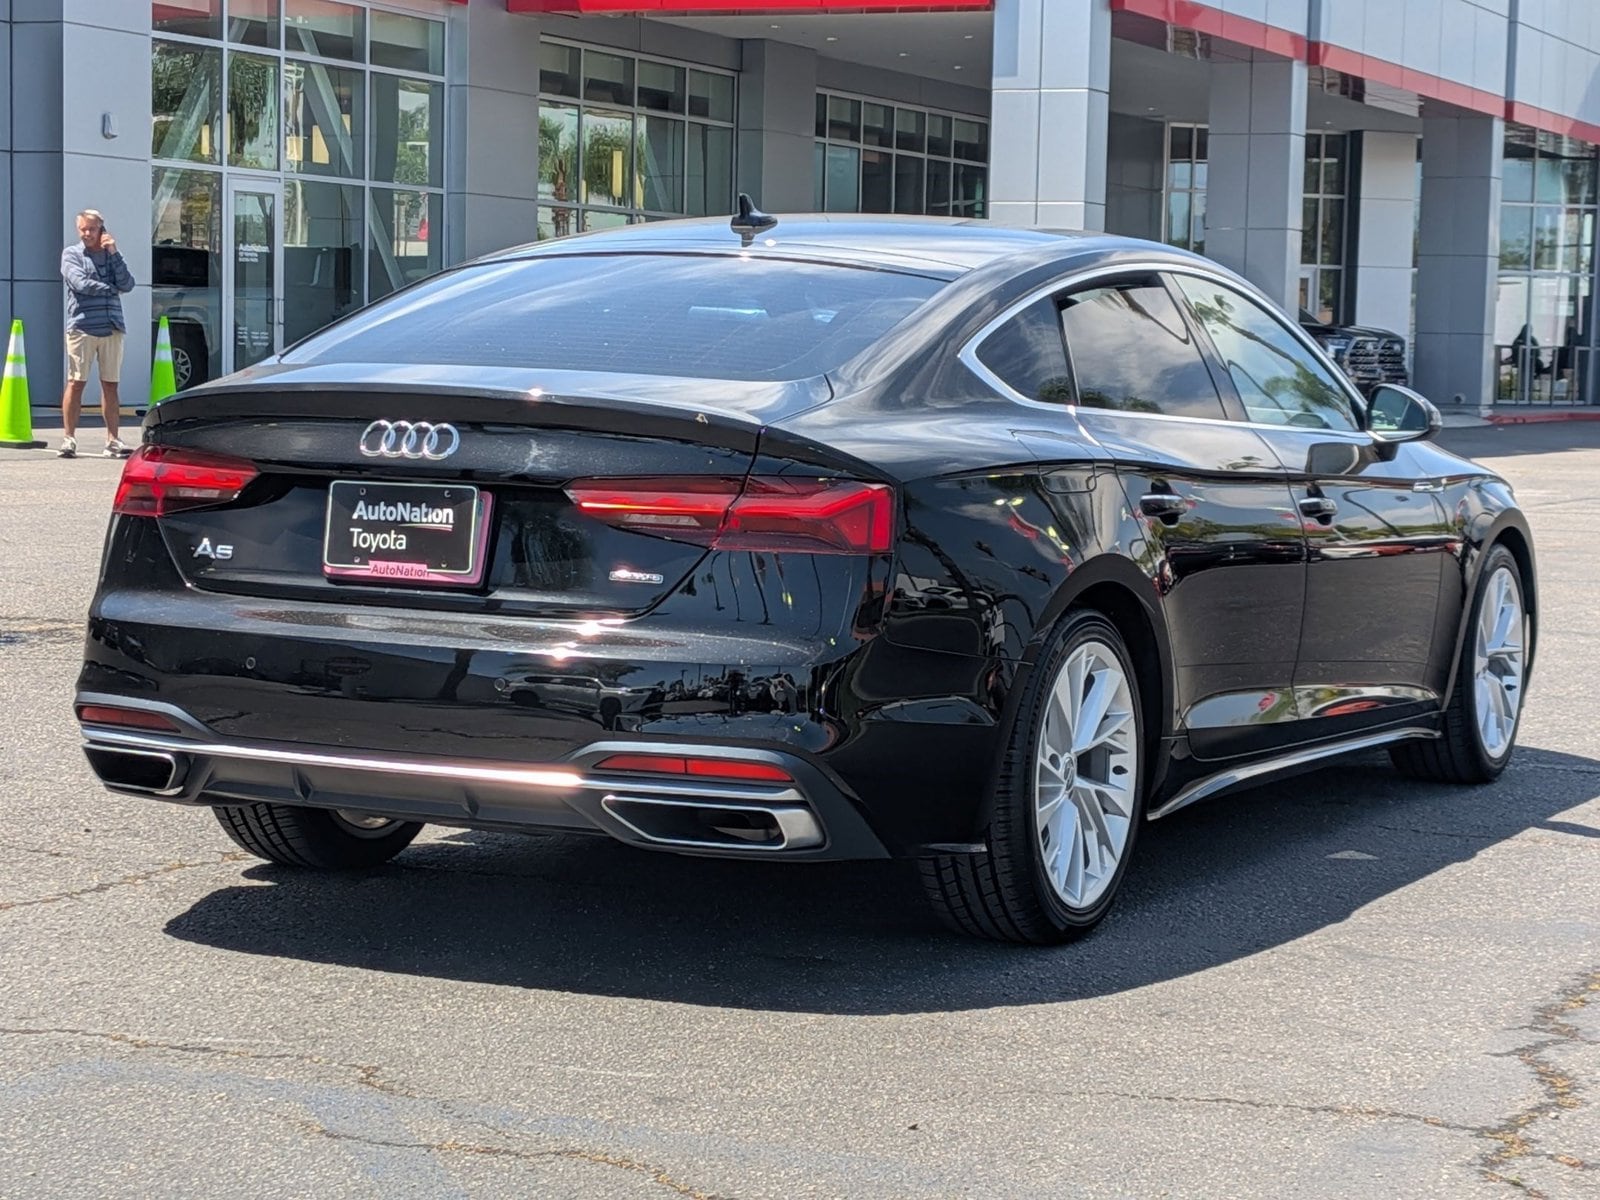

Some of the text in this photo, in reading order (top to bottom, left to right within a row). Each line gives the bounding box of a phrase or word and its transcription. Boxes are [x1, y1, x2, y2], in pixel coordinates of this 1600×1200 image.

[351, 500, 454, 524] AutoNation
[192, 537, 234, 560] A5
[349, 527, 407, 553] Toyota
[370, 564, 430, 577] AutoNation
